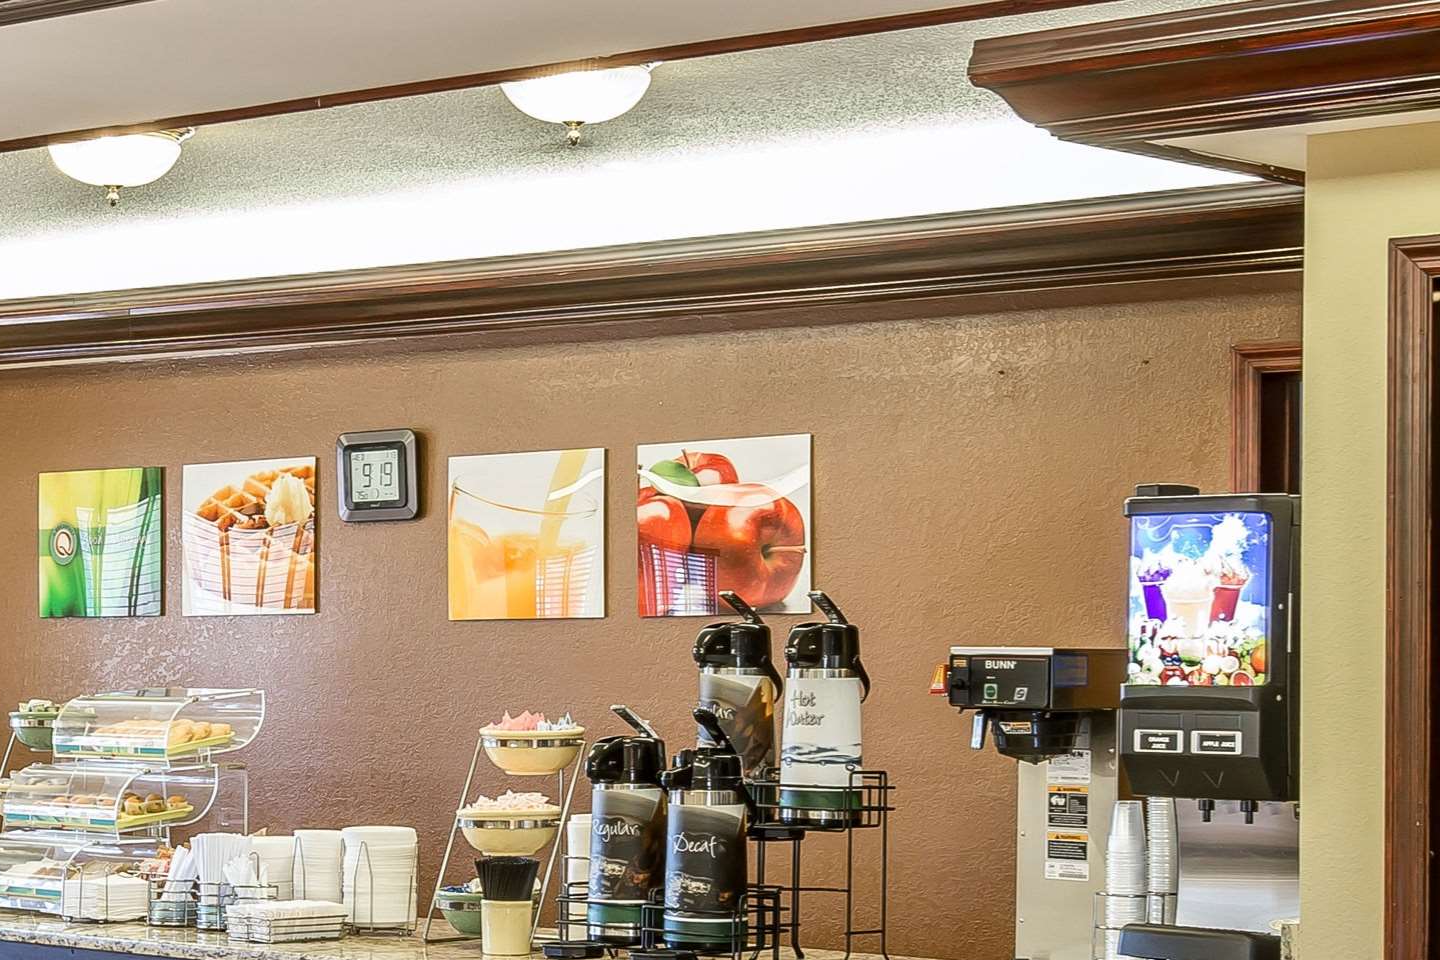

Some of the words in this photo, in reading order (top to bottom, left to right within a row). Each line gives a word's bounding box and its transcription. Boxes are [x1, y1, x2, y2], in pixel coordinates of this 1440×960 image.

[985, 660, 1015, 669] BUNN
[790, 689, 816, 708] Hot
[786, 711, 824, 728] Water
[592, 818, 640, 843] Regular
[672, 831, 718, 859] Decaf
